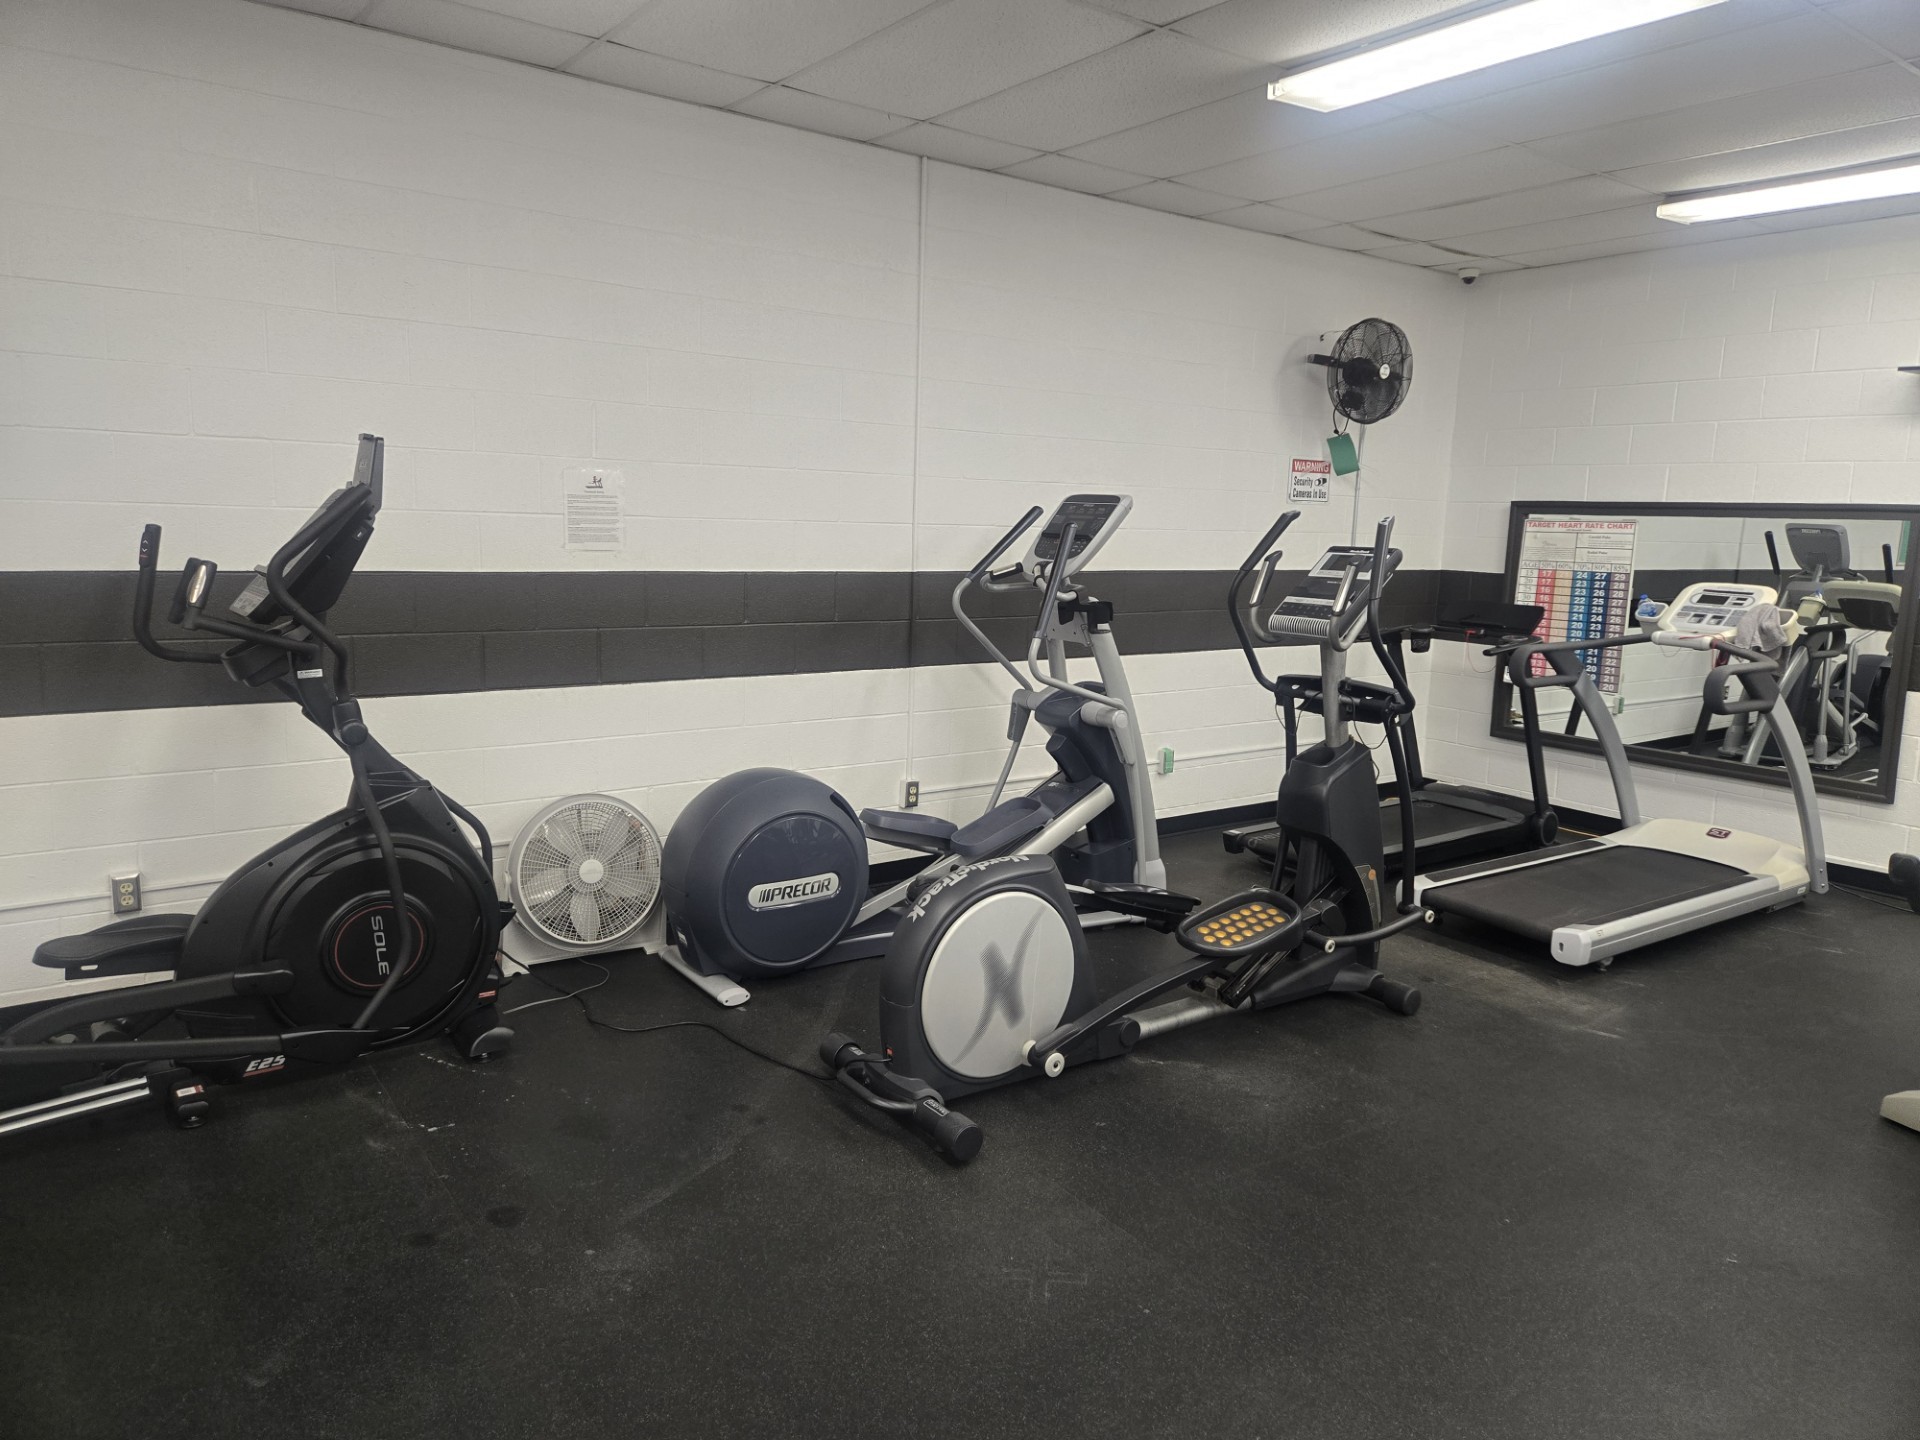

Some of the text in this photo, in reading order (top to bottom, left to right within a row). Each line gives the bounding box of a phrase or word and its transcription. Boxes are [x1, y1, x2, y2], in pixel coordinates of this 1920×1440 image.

[1294, 461, 1330, 473] WARNING
[1294, 476, 1313, 488] Security
[1292, 488, 1312, 498] Cameras
[1318, 489, 1327, 499] Use
[1594, 572, 1607, 580] 27
[1593, 589, 1605, 597] 26
[1609, 616, 1621, 624] 26
[1590, 623, 1602, 631] 23
[1589, 631, 1601, 639] 23
[1586, 656, 1597, 664] 21
[1605, 658, 1617, 666] 22
[1603, 675, 1614, 683] 21
[769, 877, 832, 902] PRECOR
[906, 854, 1030, 924] NordicTrack
[371, 915, 390, 976] SOLE
[245, 1054, 286, 1073] E25
